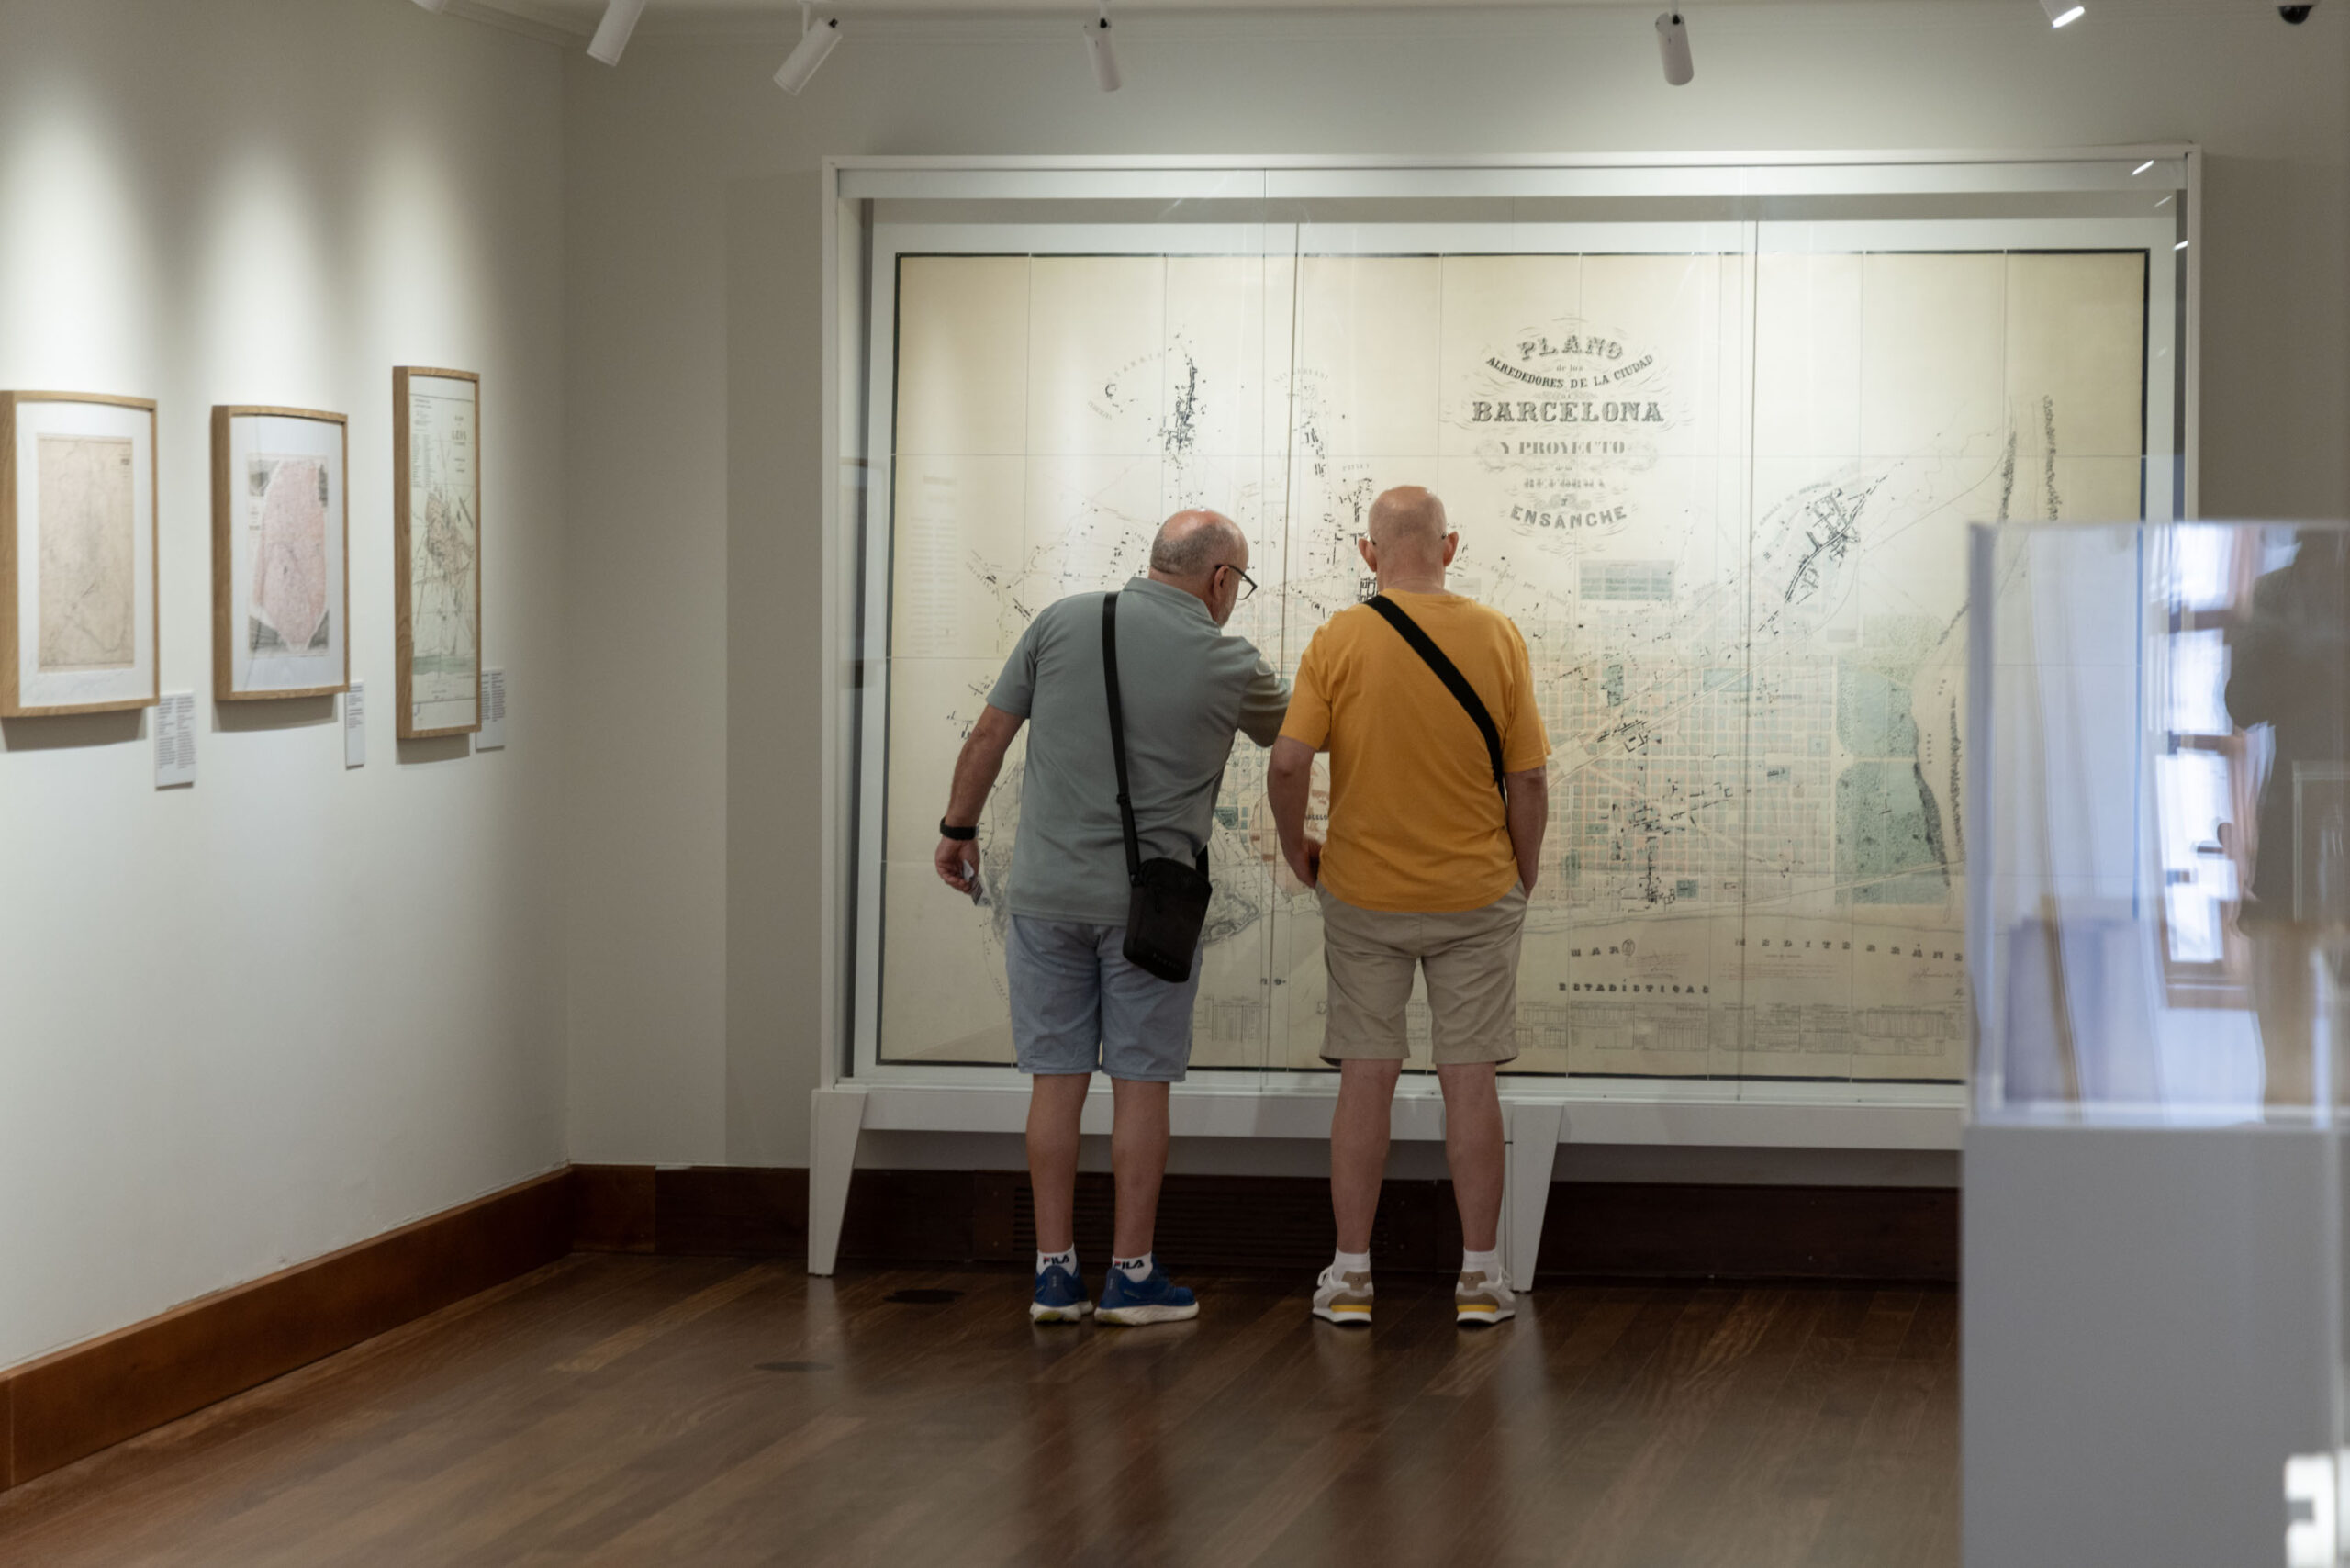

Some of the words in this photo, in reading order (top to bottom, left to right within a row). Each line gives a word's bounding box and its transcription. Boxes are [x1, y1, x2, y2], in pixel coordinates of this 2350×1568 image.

[1518, 335, 1623, 360] PLANO
[1485, 356, 1564, 389] ALREDEDORES
[1570, 378, 1588, 389] DE
[1594, 375, 1610, 386] LA
[1613, 353, 1653, 380] CIUDAD
[1472, 402, 1664, 422] BARCELONA
[1500, 442, 1510, 454] Y
[1518, 441, 1626, 455] PROYECTO
[1511, 506, 1627, 529] ENSANCHE
[1043, 1255, 1070, 1266] FILA
[1114, 1260, 1145, 1270] FILA
